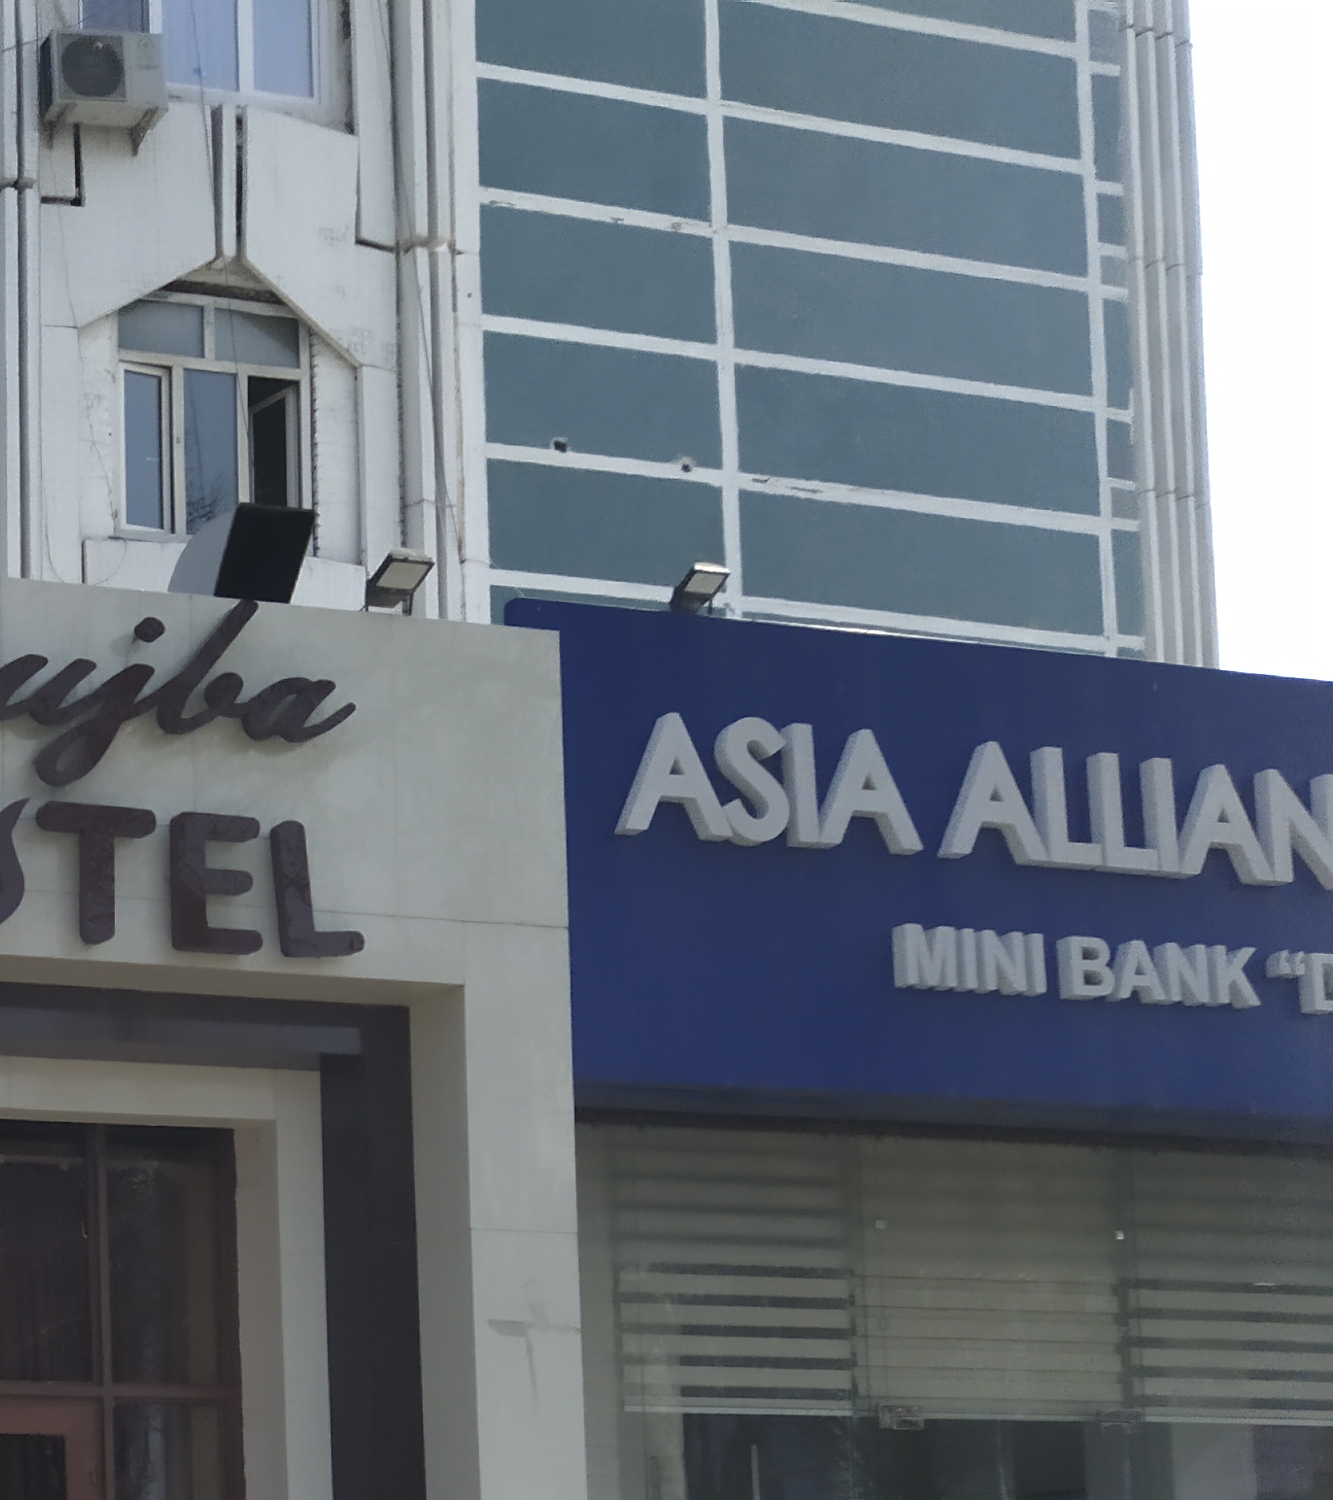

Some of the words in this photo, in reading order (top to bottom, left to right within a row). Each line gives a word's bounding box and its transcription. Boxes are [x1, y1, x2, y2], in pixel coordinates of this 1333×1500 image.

[614, 712, 924, 855] ASIA
[892, 923, 1047, 997] MINI
[1056, 935, 1262, 1009] BANK
